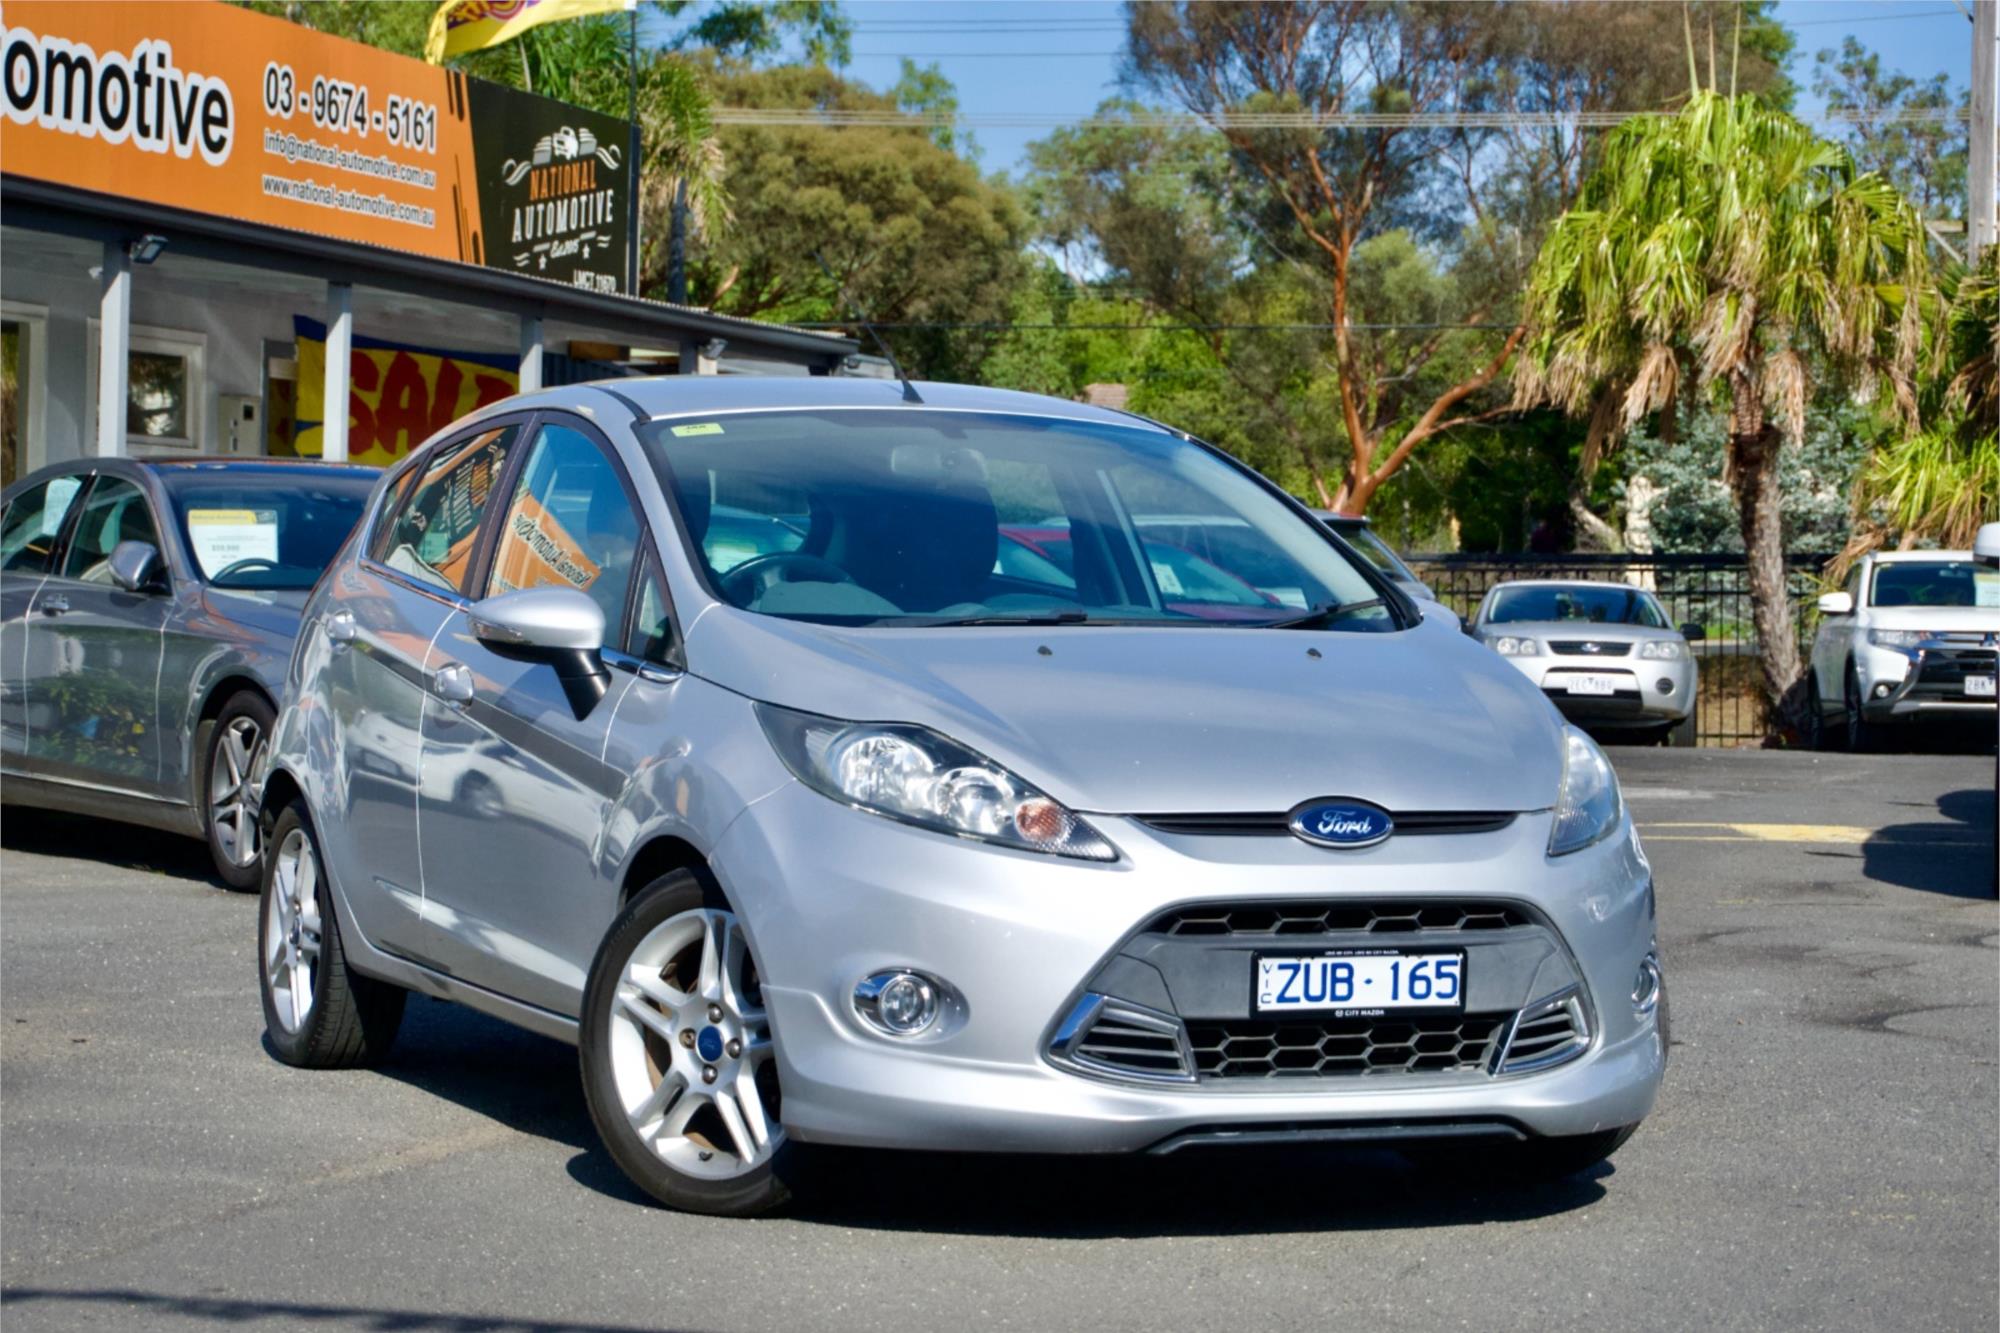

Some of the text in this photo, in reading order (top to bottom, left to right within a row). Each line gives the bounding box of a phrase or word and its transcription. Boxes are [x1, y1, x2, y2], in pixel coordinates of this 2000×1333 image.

[0, 38, 231, 156] omotive
[265, 65, 294, 115] 03
[314, 79, 367, 133] 9674
[388, 98, 436, 151] 5161
[264, 130, 436, 188] info@national-automotive.com.au
[529, 159, 597, 201] NATIONAL
[262, 175, 435, 227] www.national-automotive.com.au
[511, 188, 614, 244] AUTOMOTIVE
[1317, 810, 1372, 835] Ford
[1260, 963, 1273, 1004] VIC
[1276, 960, 1459, 1004] ZUB 165
